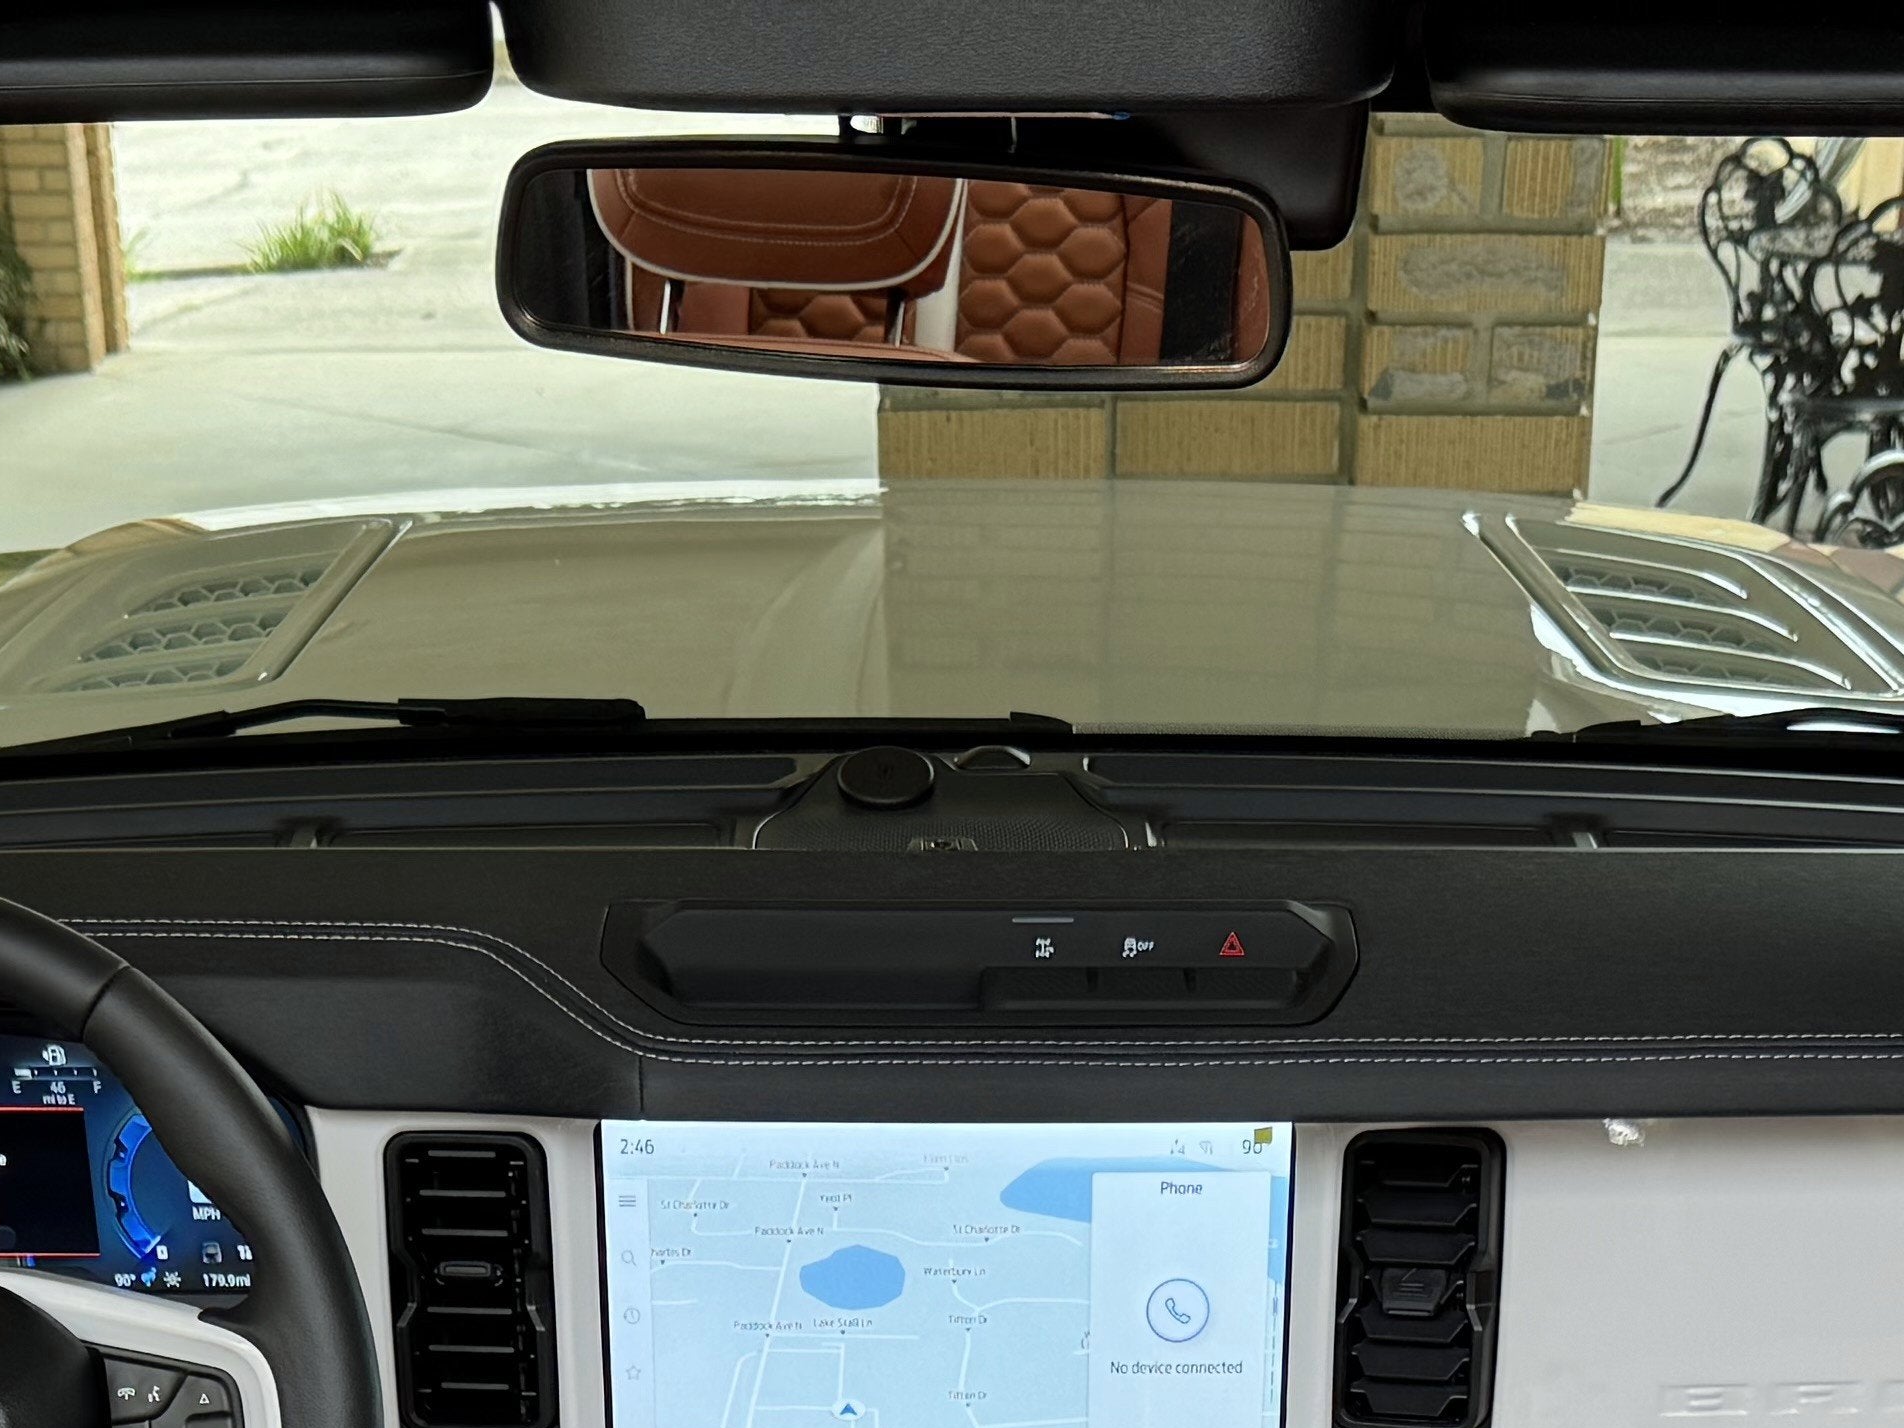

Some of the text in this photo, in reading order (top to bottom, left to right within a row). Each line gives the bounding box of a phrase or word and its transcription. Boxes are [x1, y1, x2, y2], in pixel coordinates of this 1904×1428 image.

[12, 1080, 21, 1094] E
[93, 1081, 102, 1094] F
[620, 1138, 654, 1154] 2:46
[769, 1159, 810, 1169] Paddock
[812, 1160, 832, 1169] Ave
[1160, 1181, 1203, 1194] Phone
[192, 1207, 221, 1220] MPH
[755, 1226, 824, 1236] Paddock Ave N
[156, 1245, 168, 1260] 0
[734, 1321, 773, 1331] Paddock
[776, 1321, 793, 1331] Ave
[1110, 1361, 1243, 1374] No device connected
